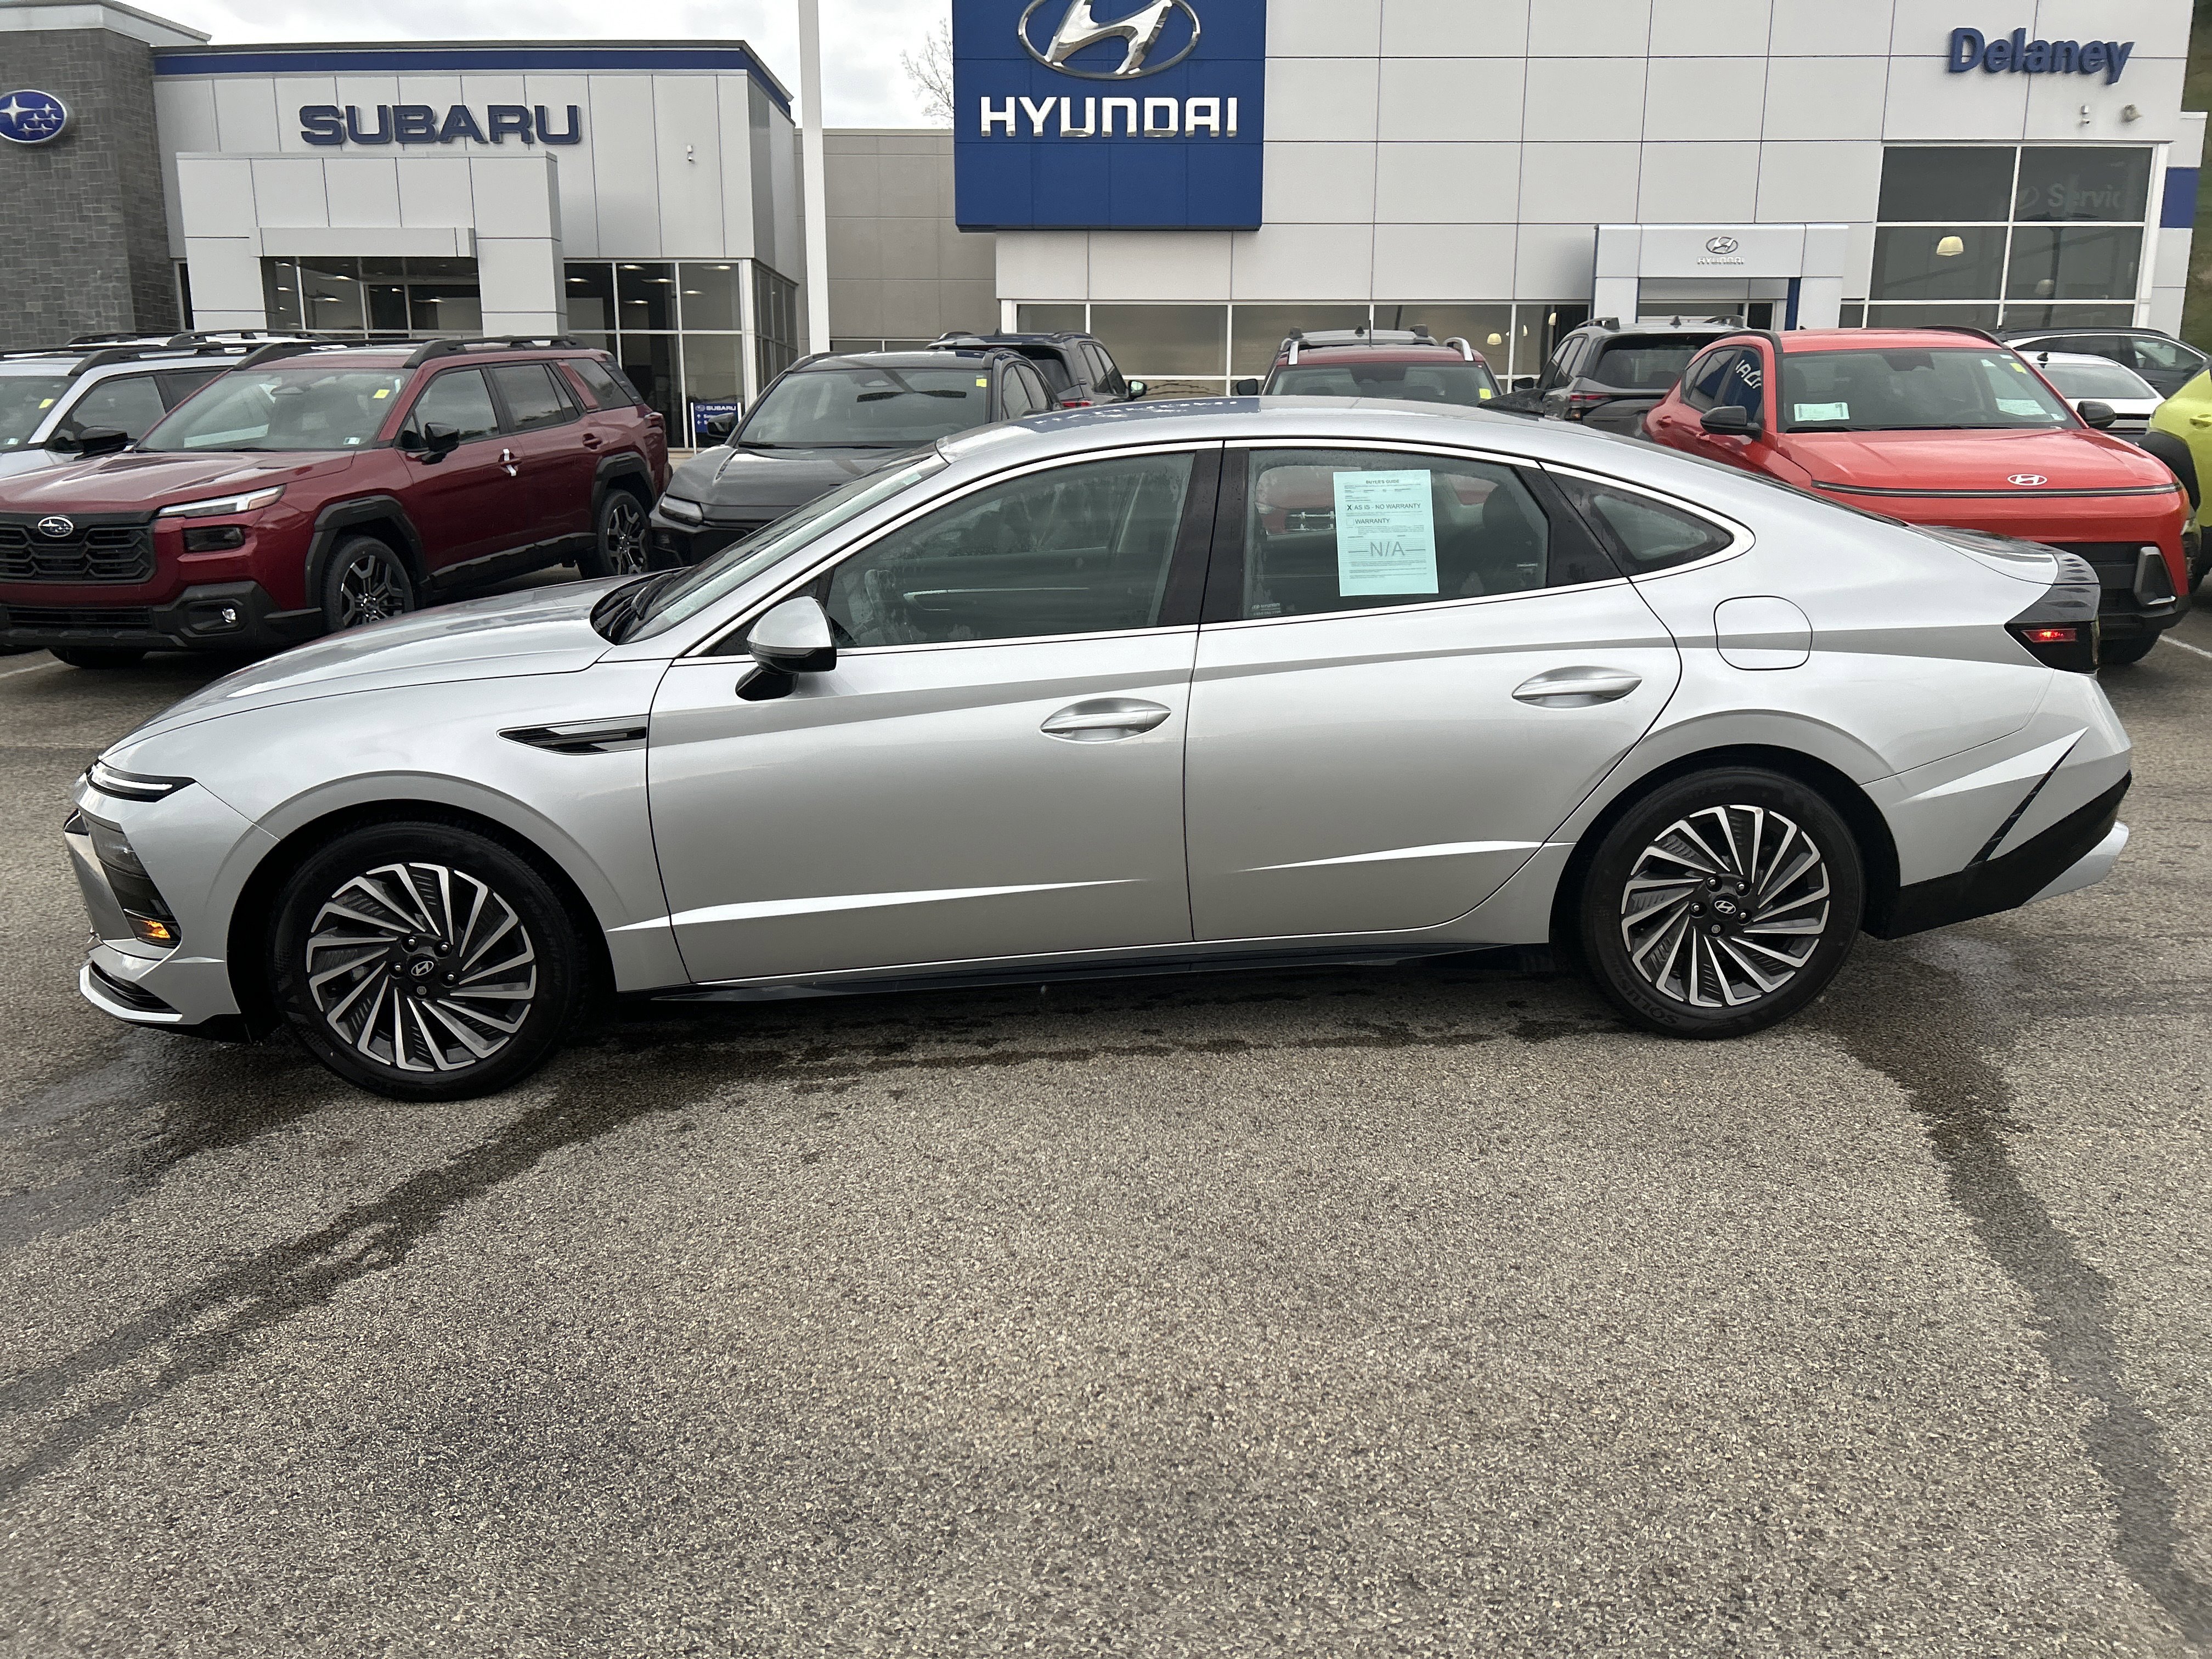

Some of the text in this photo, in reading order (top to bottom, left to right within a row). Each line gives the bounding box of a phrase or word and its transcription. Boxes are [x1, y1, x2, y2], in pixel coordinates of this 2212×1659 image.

[1948, 27, 2135, 84] Delaney
[299, 104, 582, 145] SUBARU
[980, 96, 1239, 138] HYUNDAI
[1697, 256, 1745, 265] HYUNDAI
[1370, 541, 1405, 557] N/A
